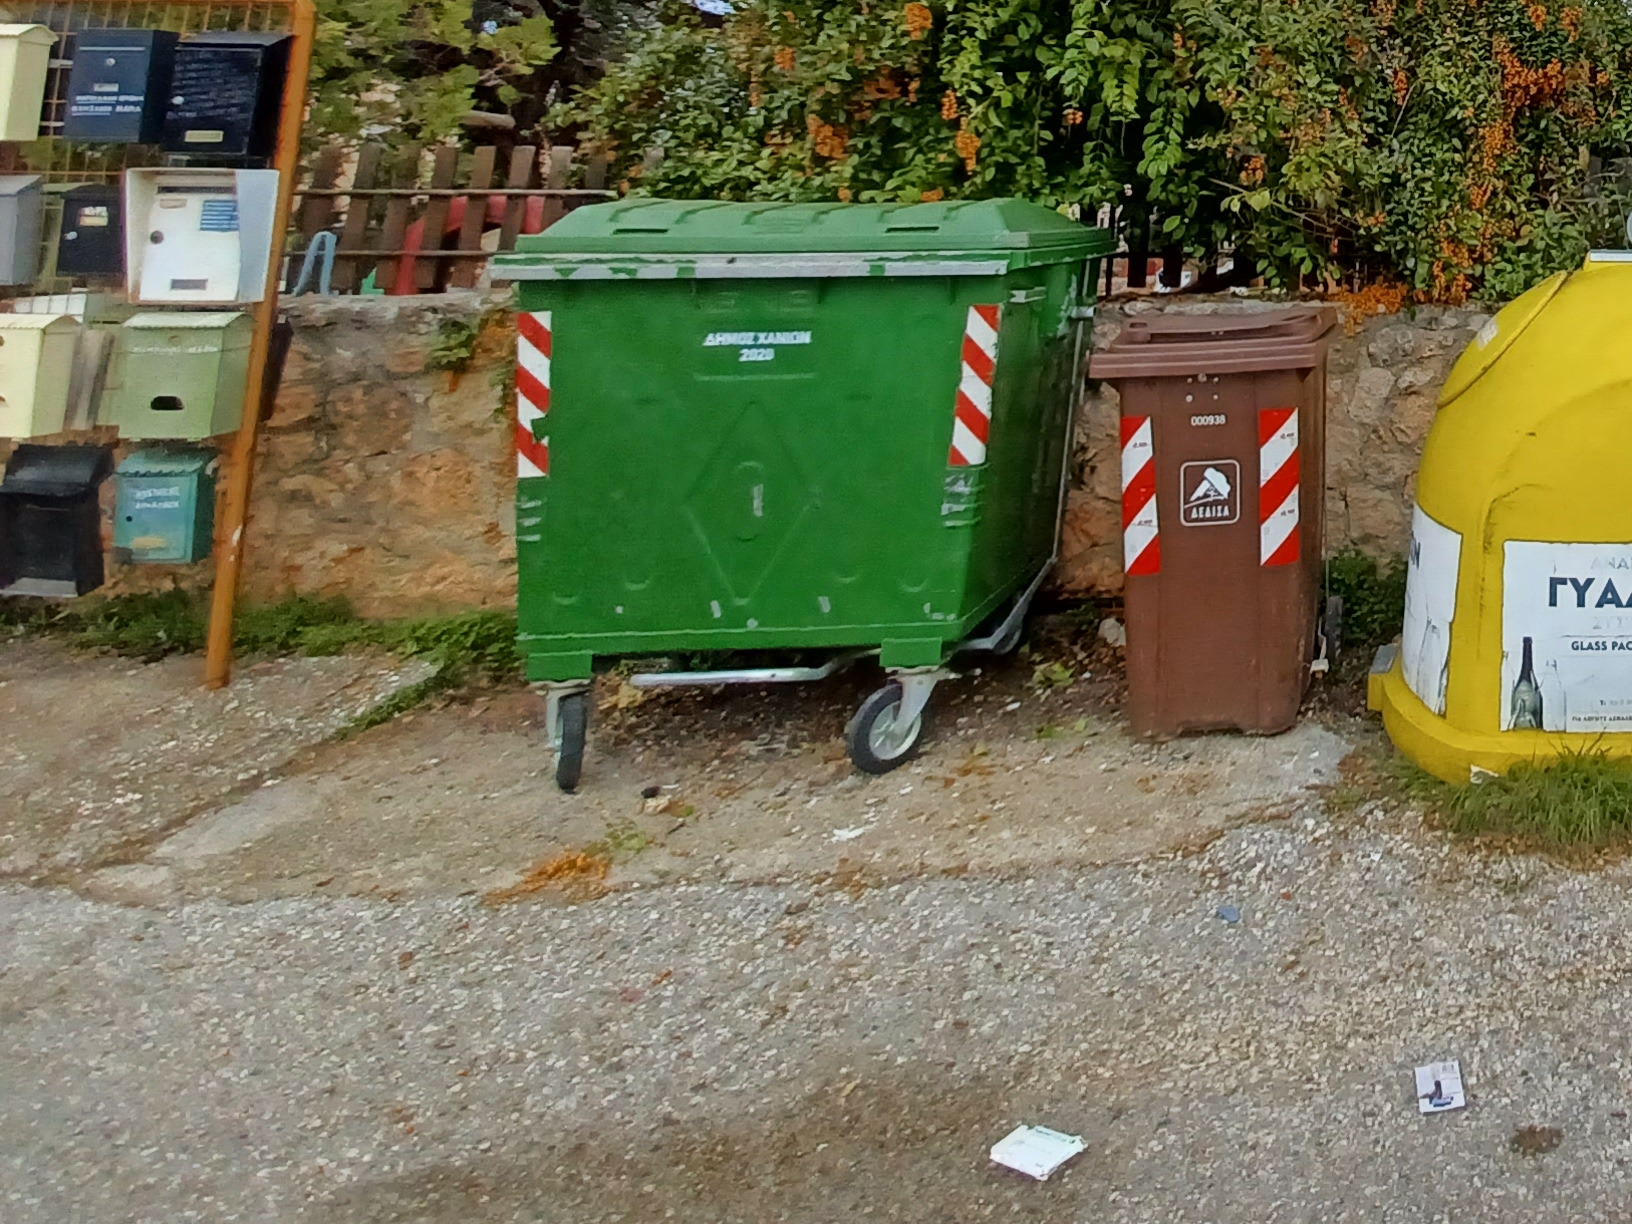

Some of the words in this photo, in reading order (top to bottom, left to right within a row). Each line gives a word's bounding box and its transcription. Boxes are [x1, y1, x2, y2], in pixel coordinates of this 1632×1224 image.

[738, 348, 775, 362] 2020
[1191, 415, 1226, 426] 000938
[1191, 506, 1230, 519] ΔΕΔΙΣΑ
[1571, 640, 1608, 651] GLASS
